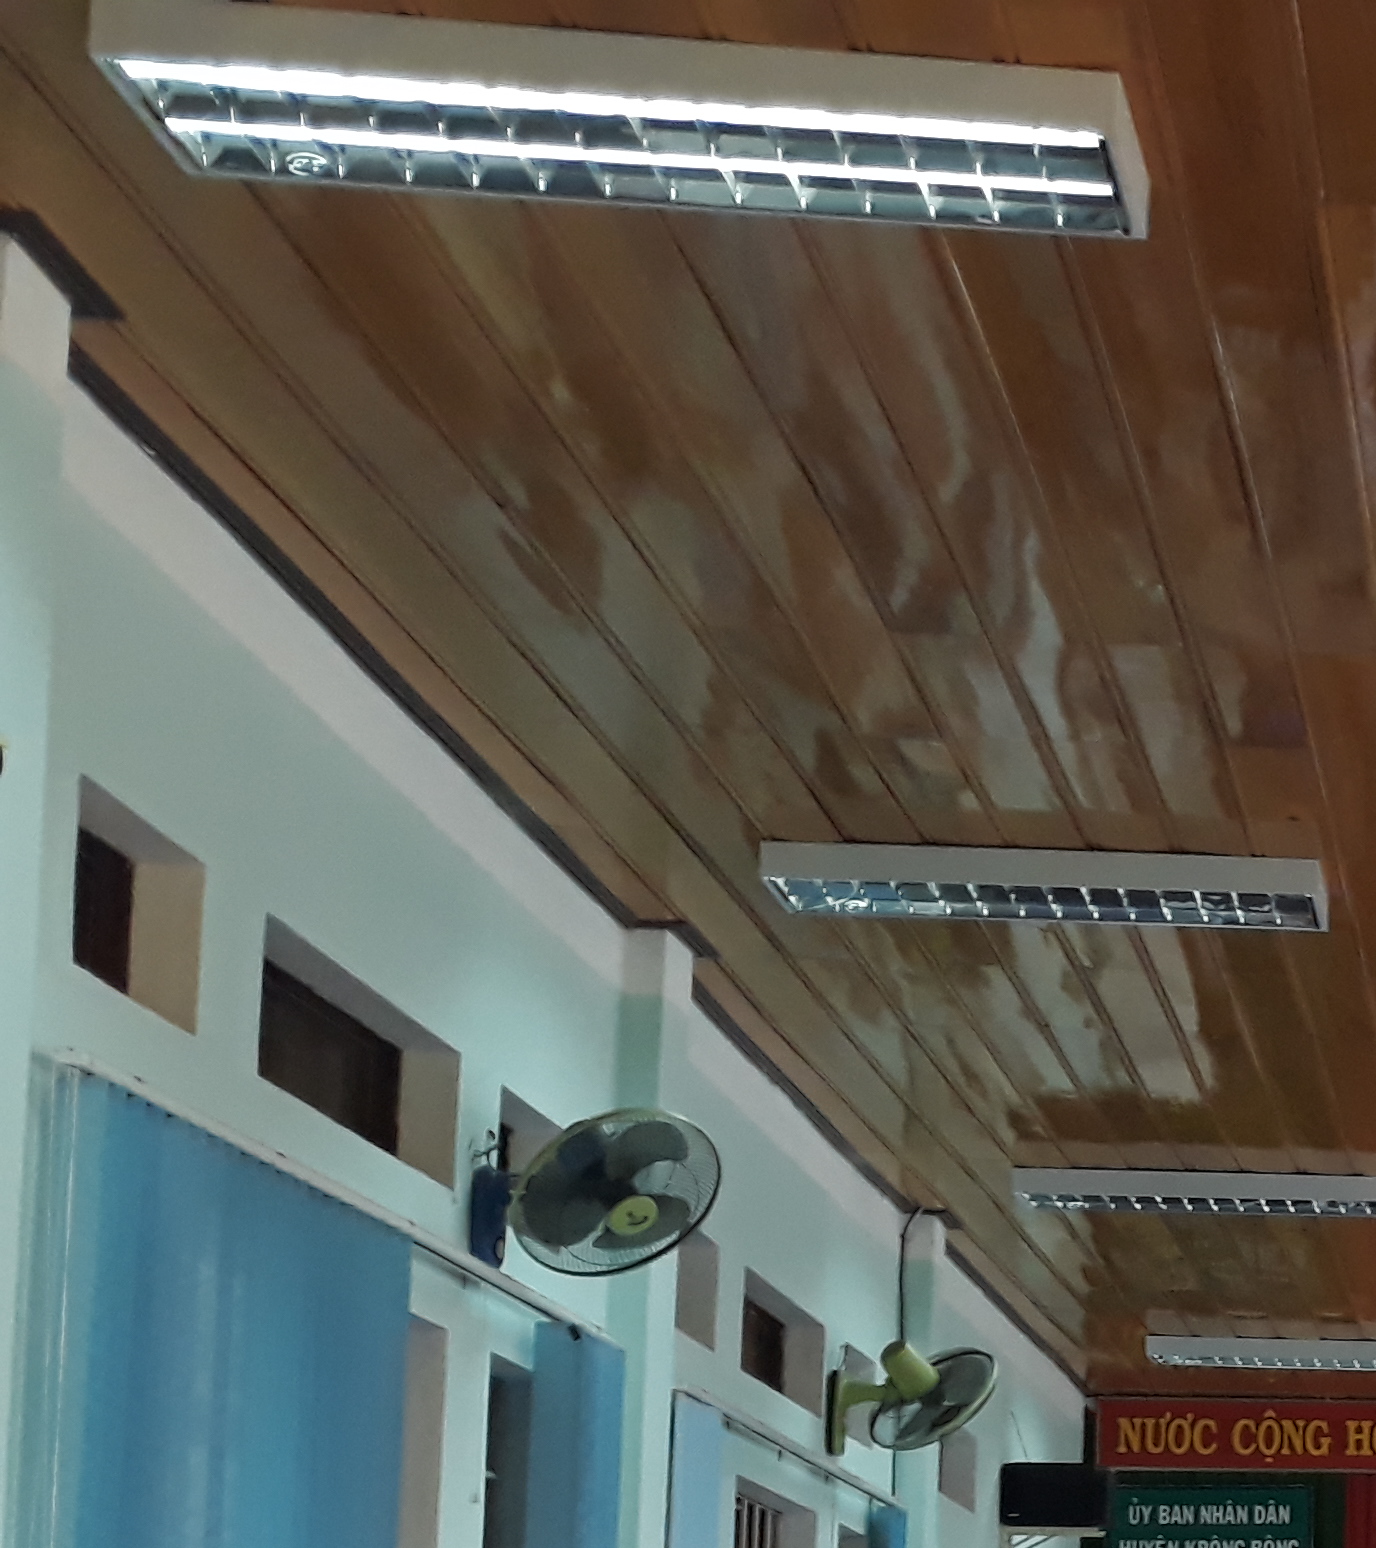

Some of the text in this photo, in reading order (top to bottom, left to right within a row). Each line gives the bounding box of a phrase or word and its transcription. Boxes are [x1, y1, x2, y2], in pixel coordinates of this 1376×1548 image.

[1231, 1409, 1331, 1462] CỘNG
[1159, 1504, 1195, 1525] BAN
[1200, 1499, 1249, 1525] NHÂN
[1254, 1499, 1291, 1525] DÂN
